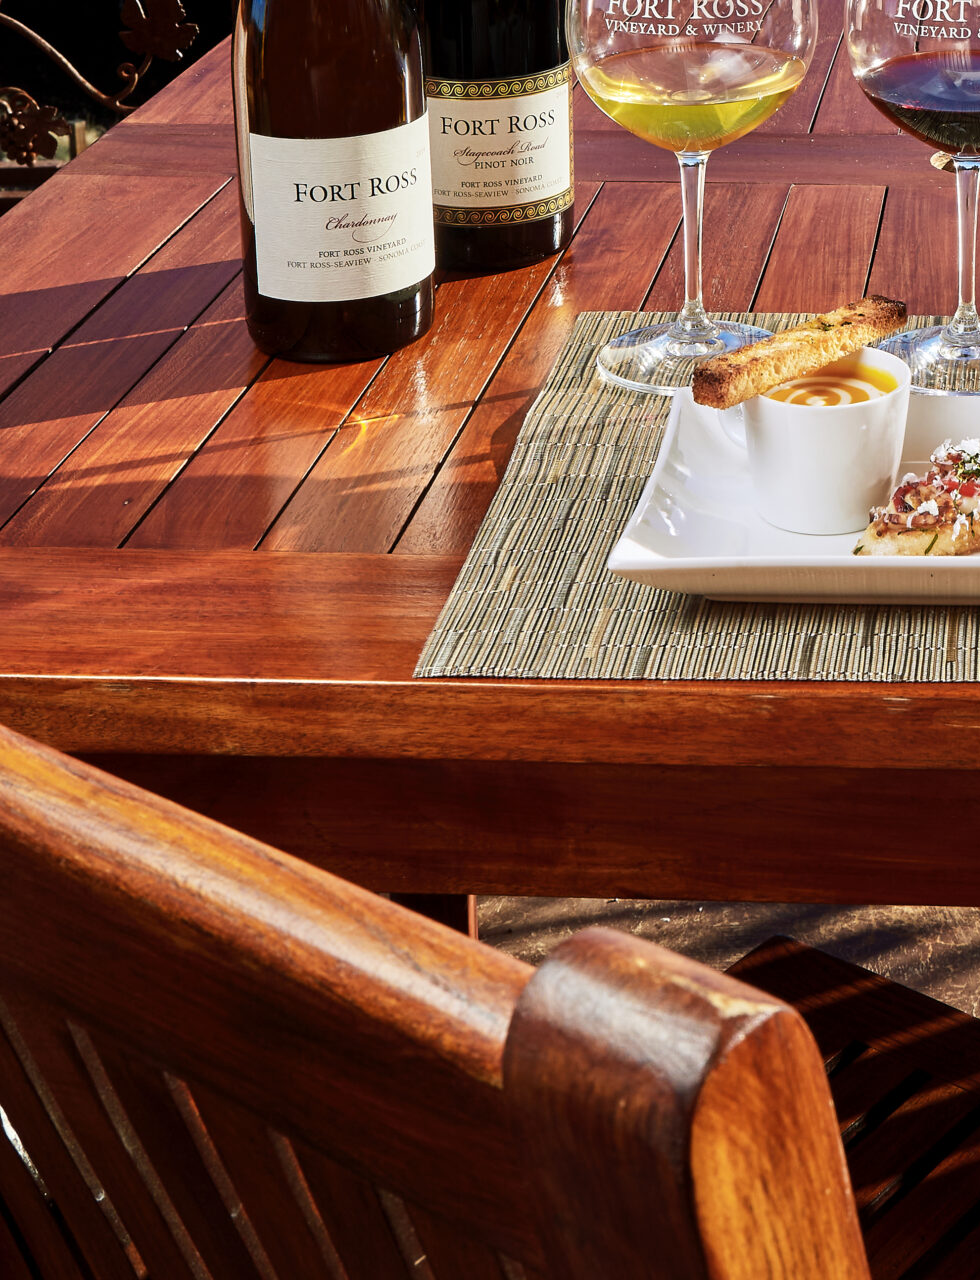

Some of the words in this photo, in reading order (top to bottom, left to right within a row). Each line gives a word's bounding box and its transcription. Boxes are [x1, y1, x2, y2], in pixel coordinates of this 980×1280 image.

[605, 19, 679, 36] VINEYARD
[685, 24, 698, 36] &
[703, 19, 764, 35] WINERY
[894, 22, 971, 39] VINEYARD
[440, 116, 500, 136] FORT
[507, 109, 555, 134] ROSS
[453, 140, 520, 166] Stagecoach
[518, 136, 549, 153] Road
[474, 160, 506, 169] PINOT
[510, 156, 534, 167] NOIR
[293, 182, 360, 202] FORT
[368, 167, 417, 197] ROSS
[483, 180, 503, 188] ROSS
[504, 174, 543, 186] VINEYARD
[434, 188, 451, 197] FORT
[325, 211, 398, 243] Chardonnay
[343, 248, 365, 257] ROSS
[366, 237, 407, 253] VINEYARD
[287, 260, 307, 269] FORT
[378, 247, 409, 262] SONOMA
